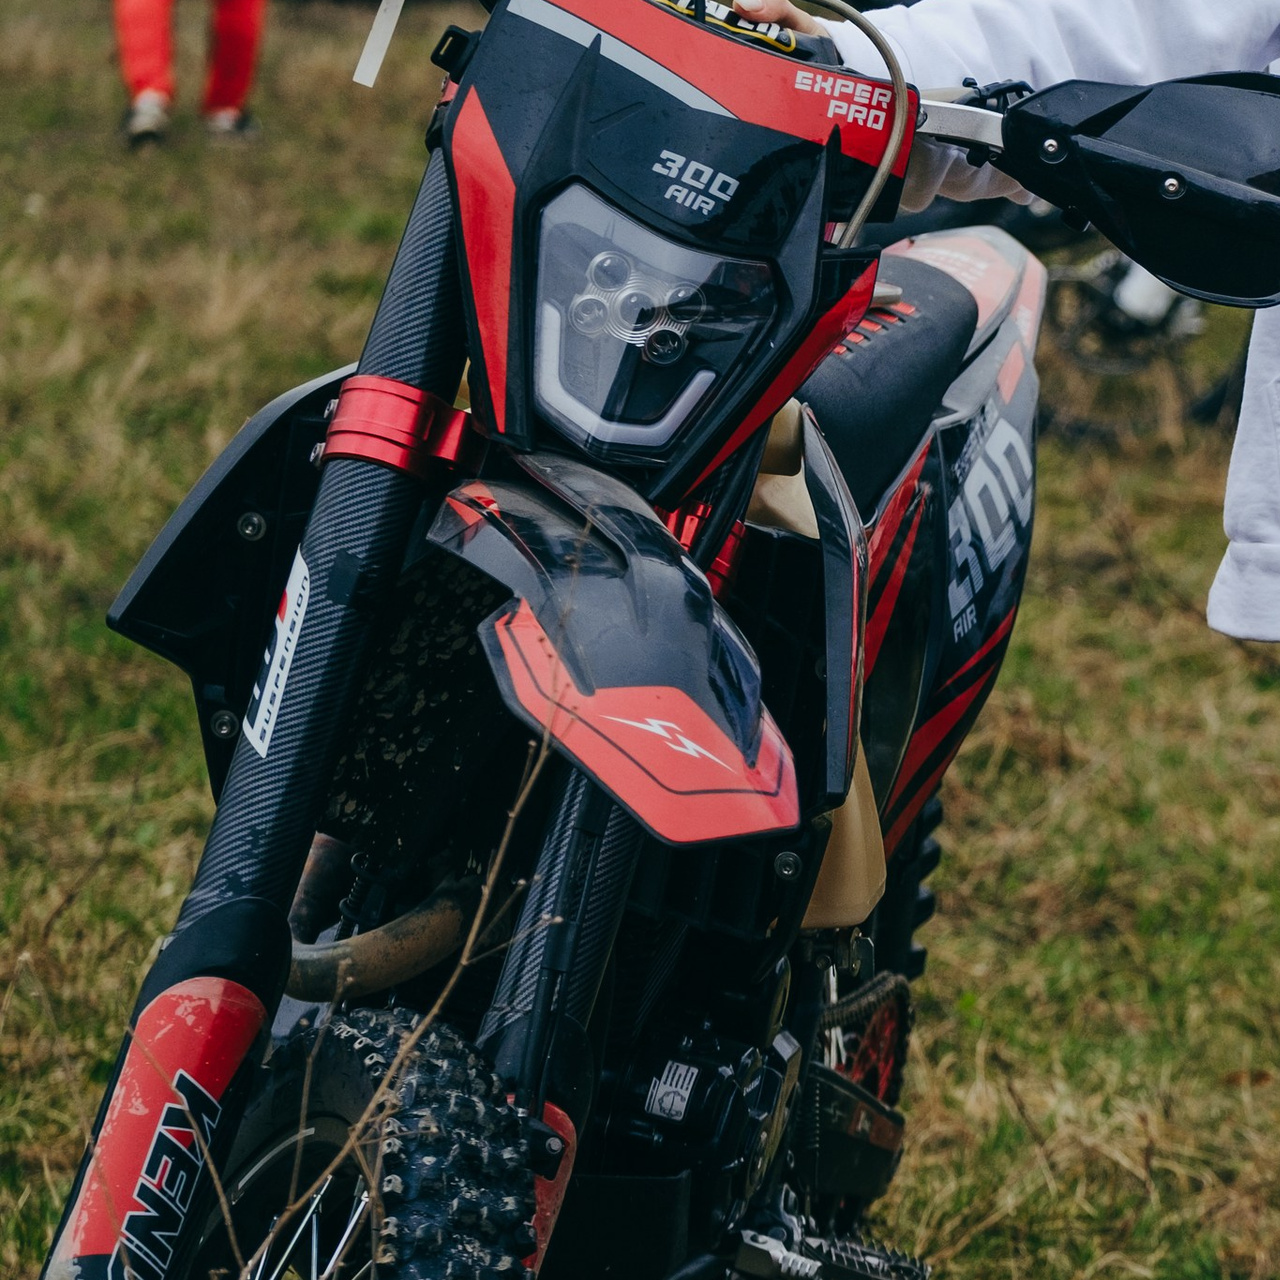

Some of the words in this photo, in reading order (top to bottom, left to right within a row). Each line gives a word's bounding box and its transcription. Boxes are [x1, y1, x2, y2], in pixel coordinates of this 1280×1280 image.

[827, 99, 887, 131] PRO
[652, 149, 740, 202] 300
[664, 184, 716, 216] AIR
[948, 418, 1033, 619] 300
[953, 603, 977, 644] AIR
